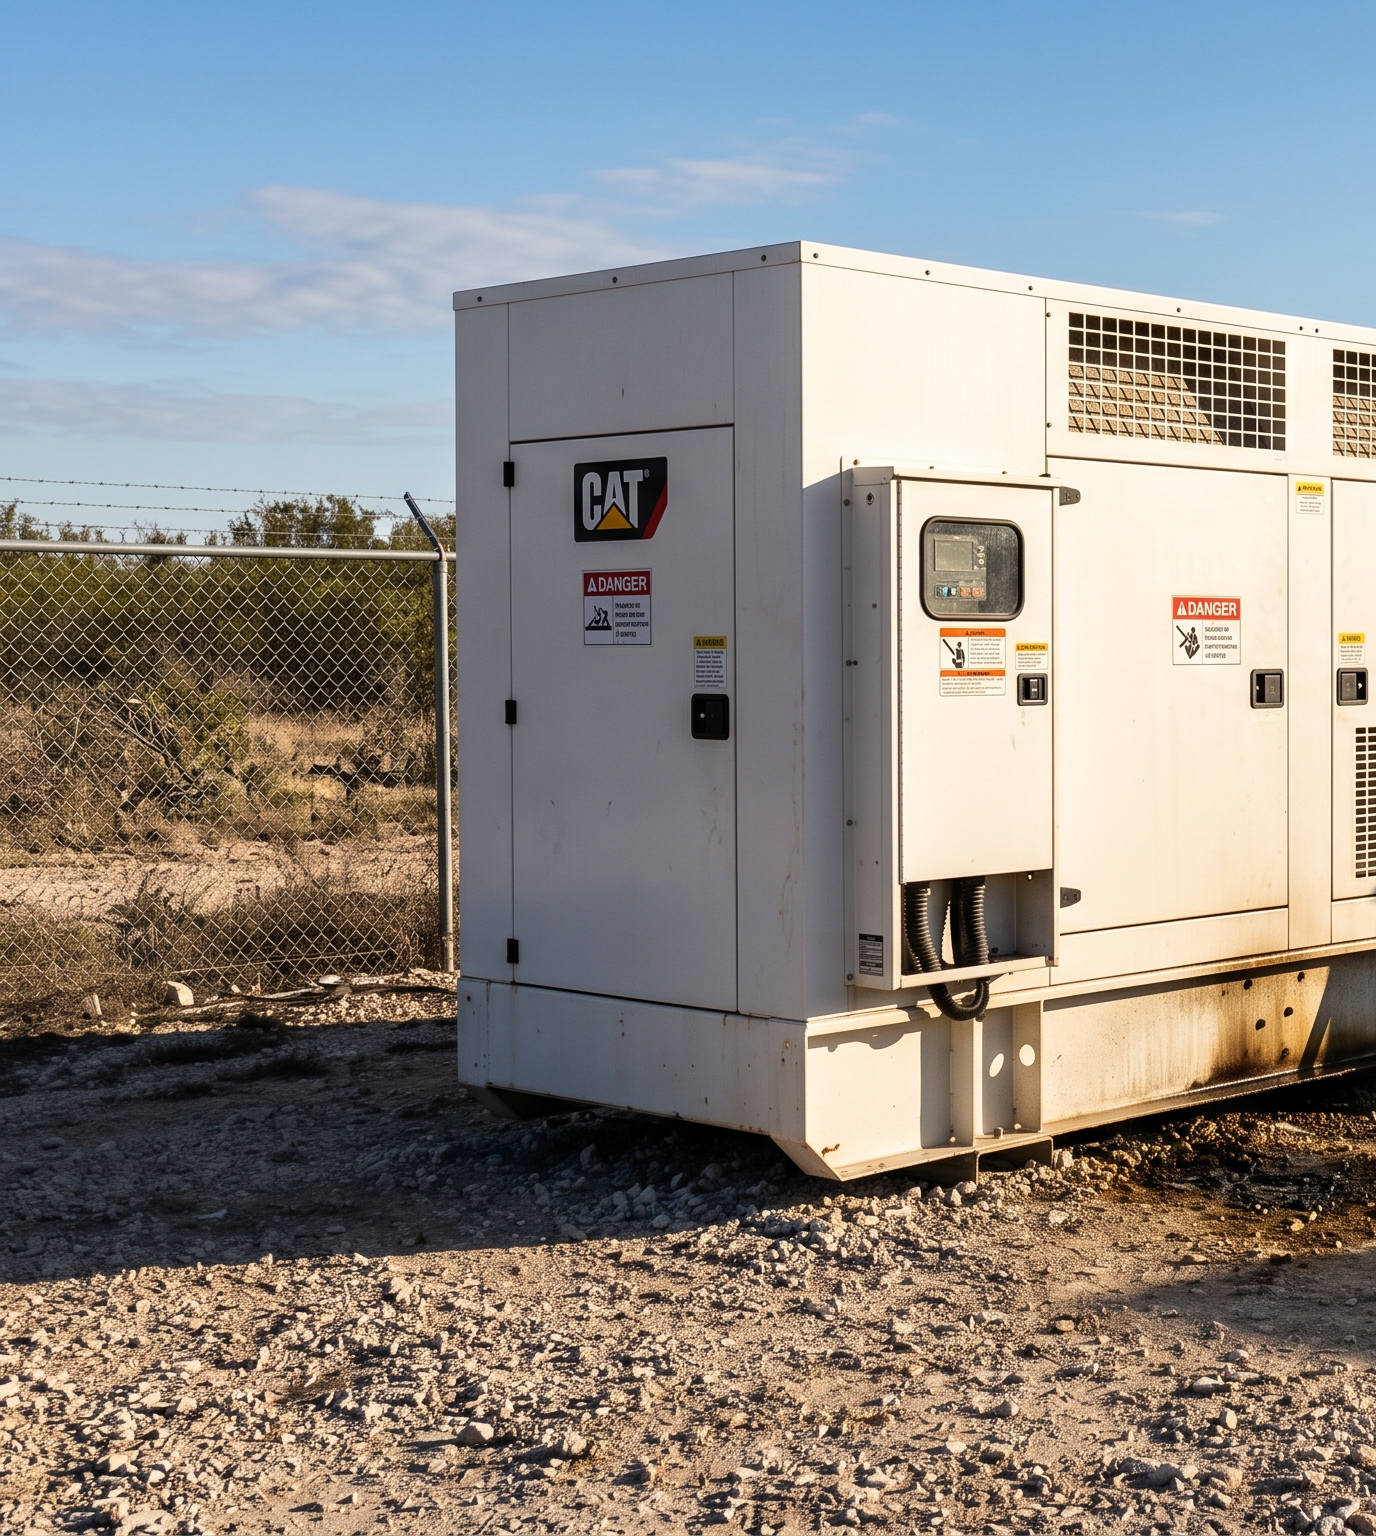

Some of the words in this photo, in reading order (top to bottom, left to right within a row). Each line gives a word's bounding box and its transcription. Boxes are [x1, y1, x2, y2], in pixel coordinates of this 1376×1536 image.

[582, 469, 643, 530] CAT
[598, 576, 647, 592] DANGER
[1188, 601, 1237, 616] DANGER
